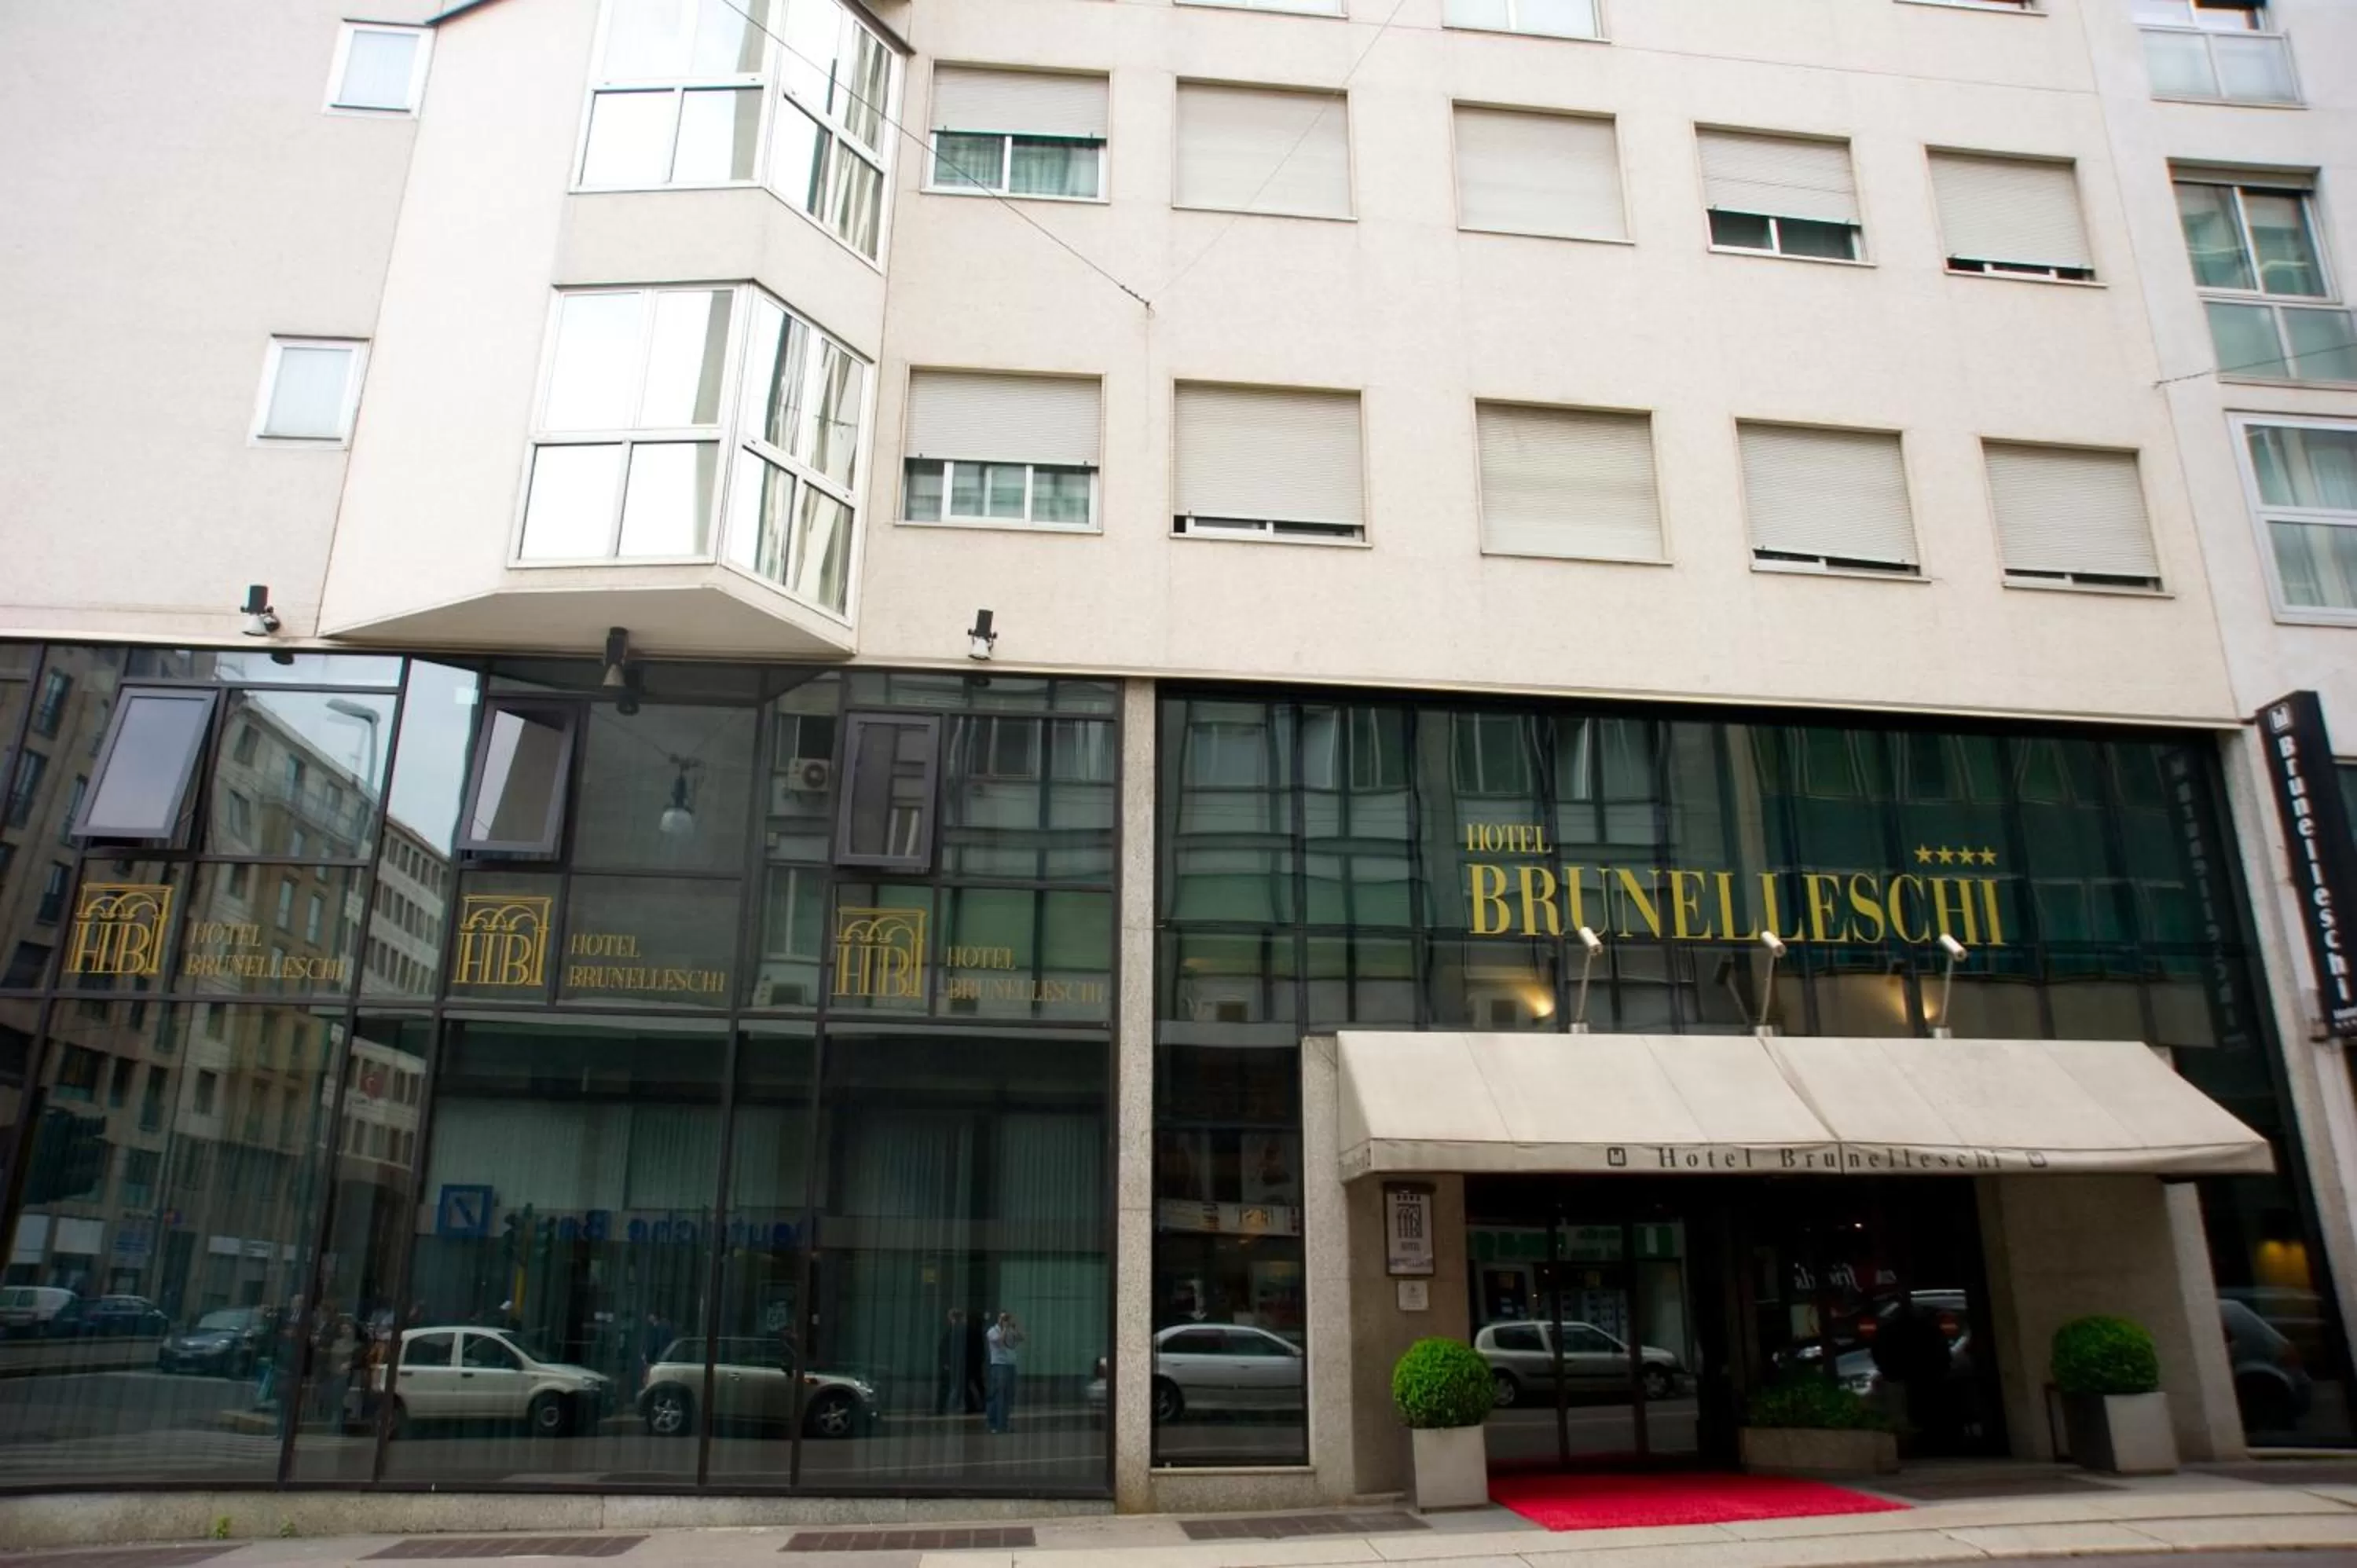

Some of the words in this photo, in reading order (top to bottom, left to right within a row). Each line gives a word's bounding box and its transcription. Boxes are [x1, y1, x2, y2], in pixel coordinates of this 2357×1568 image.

[1466, 822, 1552, 855] HOTEL
[2278, 735, 2352, 1002] Brunelleschi
[1467, 863, 2008, 948] BRUNELLESCHI
[190, 922, 261, 947] HOTEL
[571, 932, 641, 958] HOTEL
[184, 954, 346, 981] BRUNELLESCHI
[947, 946, 1017, 971] HOTEL
[566, 965, 725, 992] BRUNELLESCHI
[948, 977, 1103, 1003] BRUNELLESCHI
[1658, 1147, 1753, 1169] Hotel
[1780, 1148, 2002, 1170] Brunelleschi
